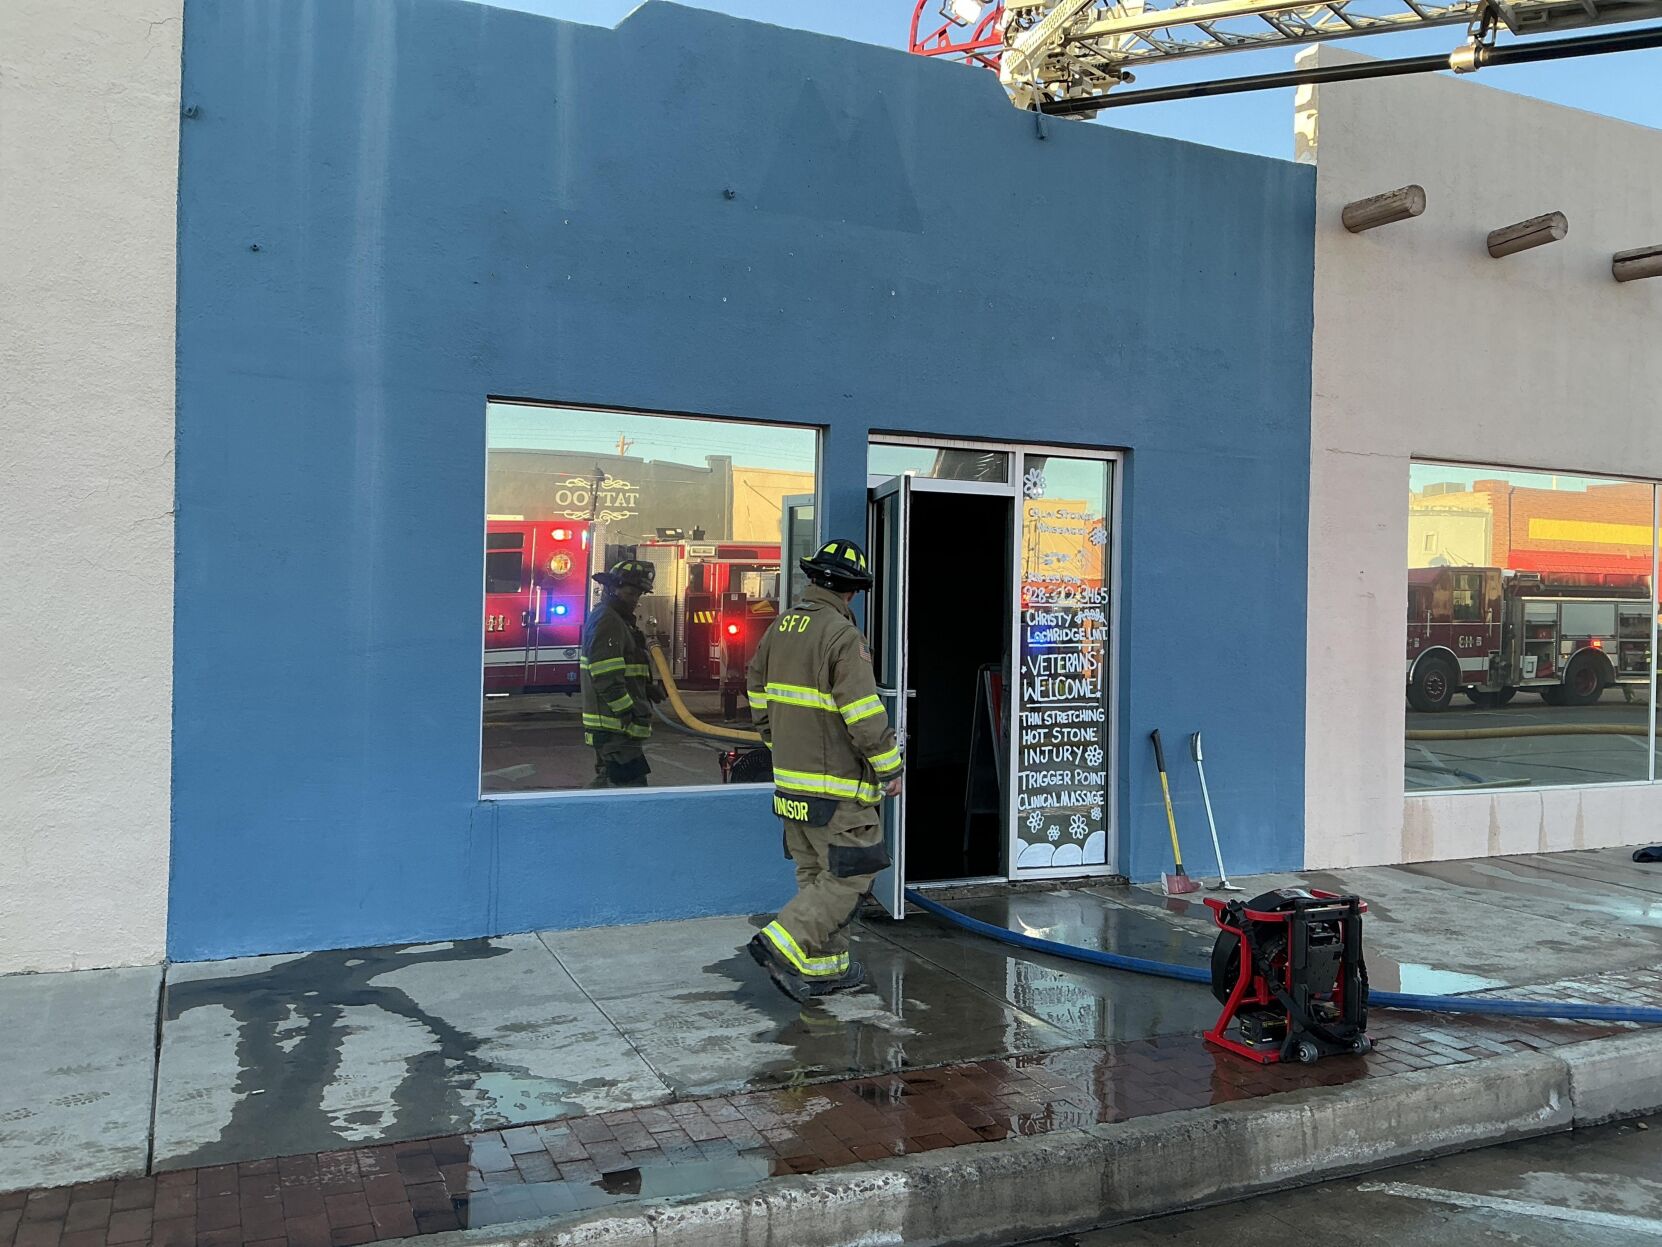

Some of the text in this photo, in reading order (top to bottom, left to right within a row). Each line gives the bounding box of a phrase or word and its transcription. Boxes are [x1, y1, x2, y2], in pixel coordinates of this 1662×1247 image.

[779, 614, 811, 633] SFD
[1026, 610, 1072, 627] CHRISTY
[1027, 627, 1086, 643] LOCHRIDGE
[1027, 652, 1098, 676] VETERANS
[1044, 708, 1105, 725] STRETCHING
[1022, 727, 1098, 745] HOT STONE
[1024, 745, 1083, 767] INJURY
[1018, 769, 1107, 790] TRIGGER POINT
[1018, 790, 1105, 811] CLINICAL MASSAGE
